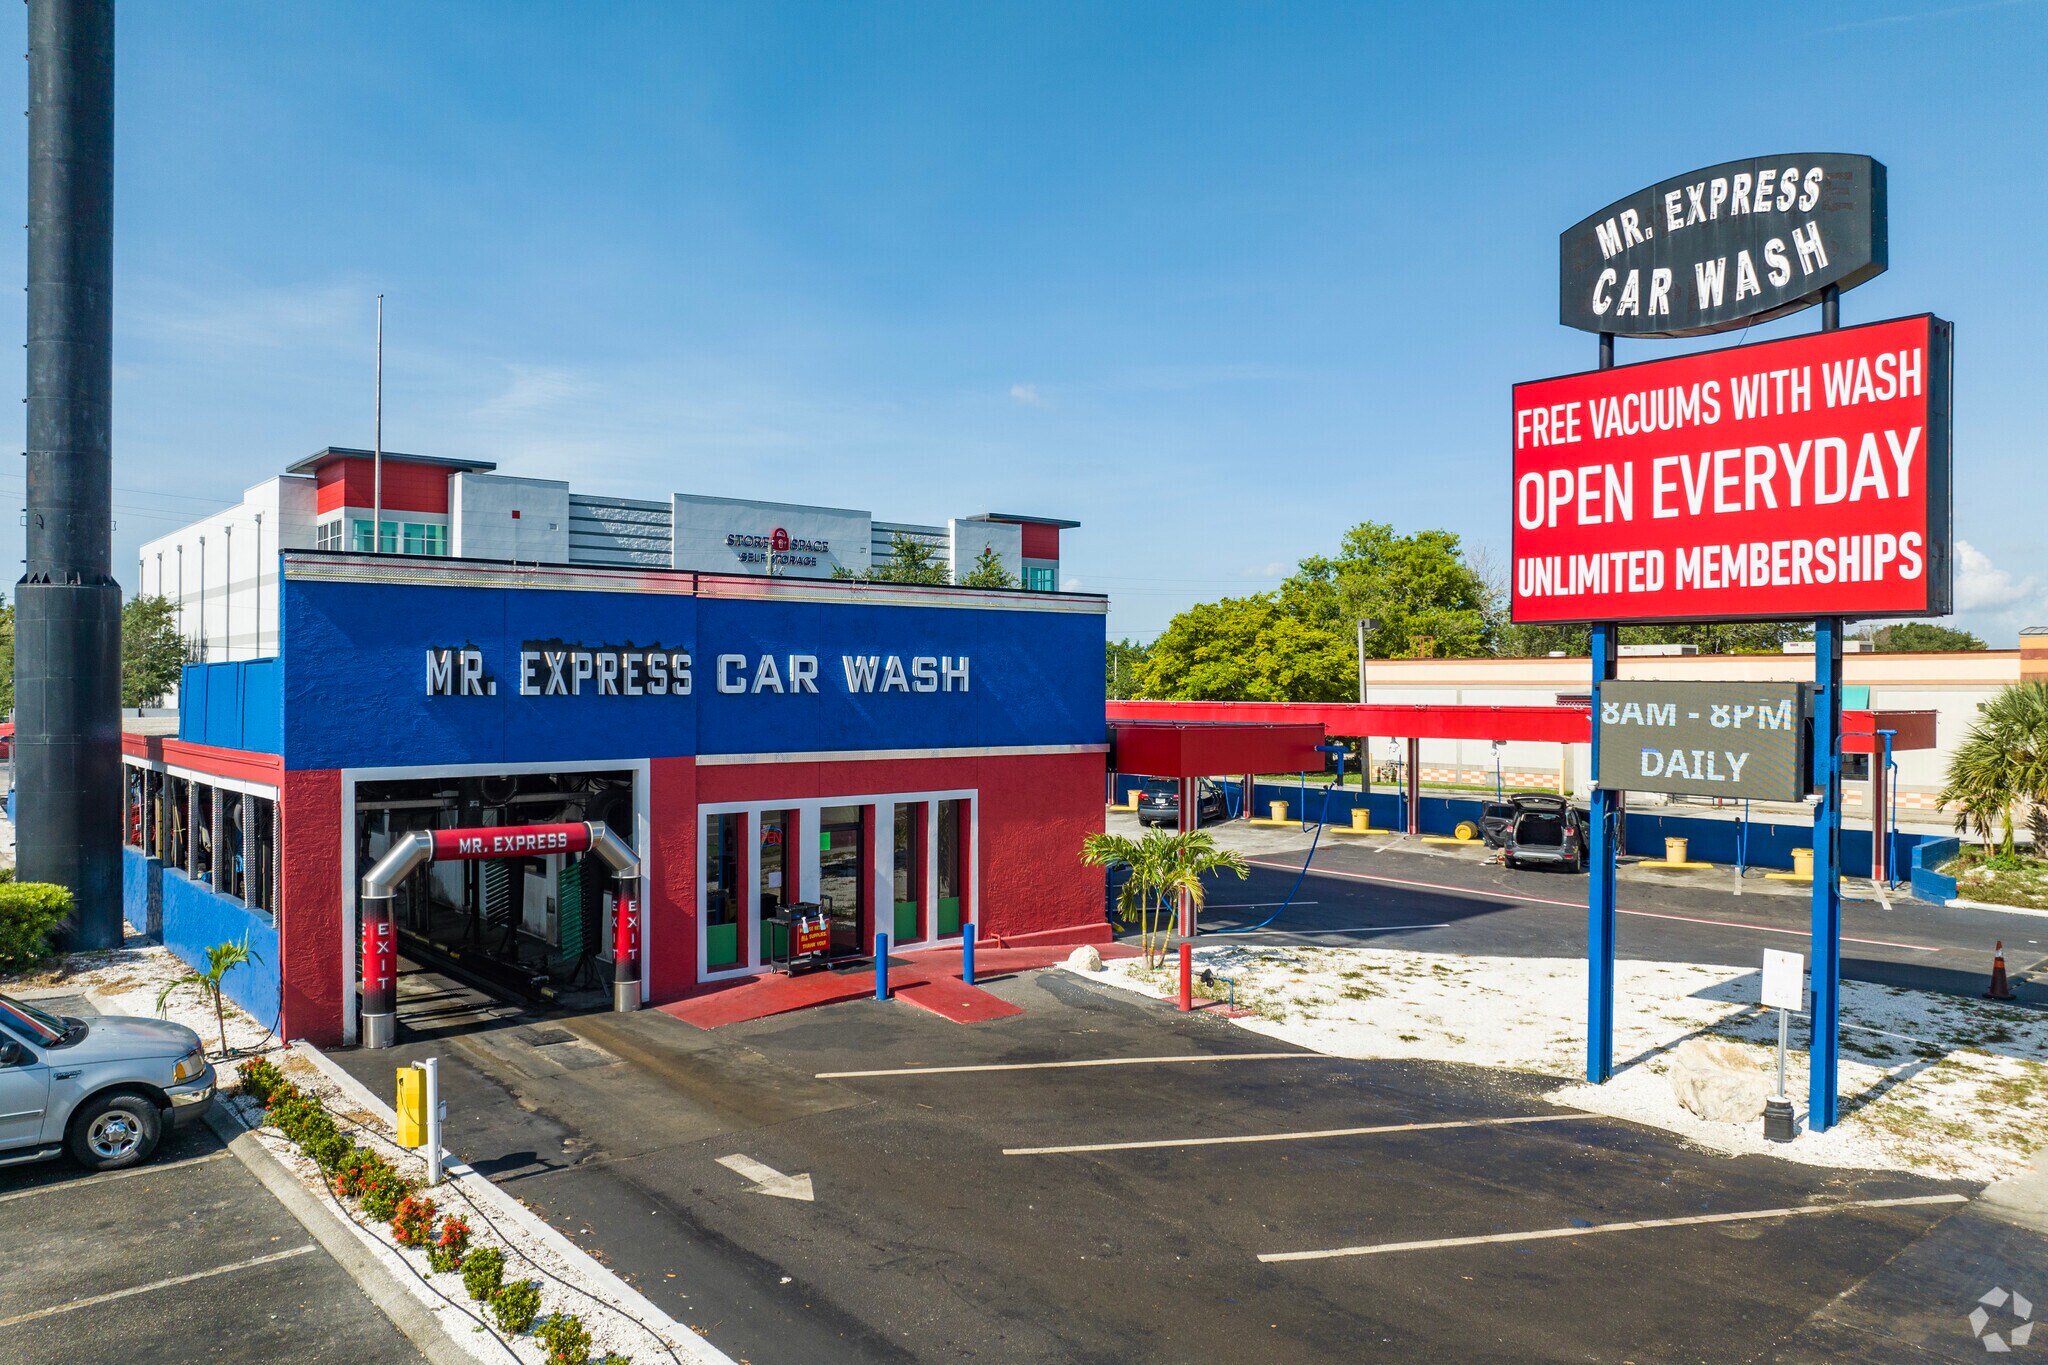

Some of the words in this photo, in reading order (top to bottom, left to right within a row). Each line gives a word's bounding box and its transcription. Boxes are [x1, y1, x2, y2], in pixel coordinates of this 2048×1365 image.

[1595, 211, 1653, 260] MR.
[1665, 166, 1825, 232] EXPRESS
[1592, 267, 1672, 317] CAR
[1694, 220, 1829, 310] WASH
[1518, 401, 1581, 449] FREE
[1589, 380, 1721, 440] VACUUMS
[1730, 365, 1810, 420] WITH
[1821, 348, 1922, 408] WASH
[1518, 461, 1634, 530] OPEN
[1653, 426, 1922, 520] EVERYDAY
[726, 534, 770, 549] STORE
[790, 538, 829, 553] SPACE
[738, 552, 766, 563] SELF
[1518, 549, 1664, 597] UNLIMITED
[1676, 531, 1922, 590] MEMBERSHIPS
[426, 649, 497, 696] MR.
[519, 650, 692, 696] EXPRESS
[716, 654, 819, 694] CAR
[842, 655, 969, 694] WASH
[1601, 702, 1676, 727] 8AM
[1710, 698, 1792, 731] 8PM
[1641, 748, 1749, 782] DAILY
[459, 837, 488, 854] MR.
[494, 832, 567, 853] EXPRESS
[760, 831, 782, 844] PEN
[376, 923, 390, 990] EXIT
[627, 900, 638, 960] EXIT
